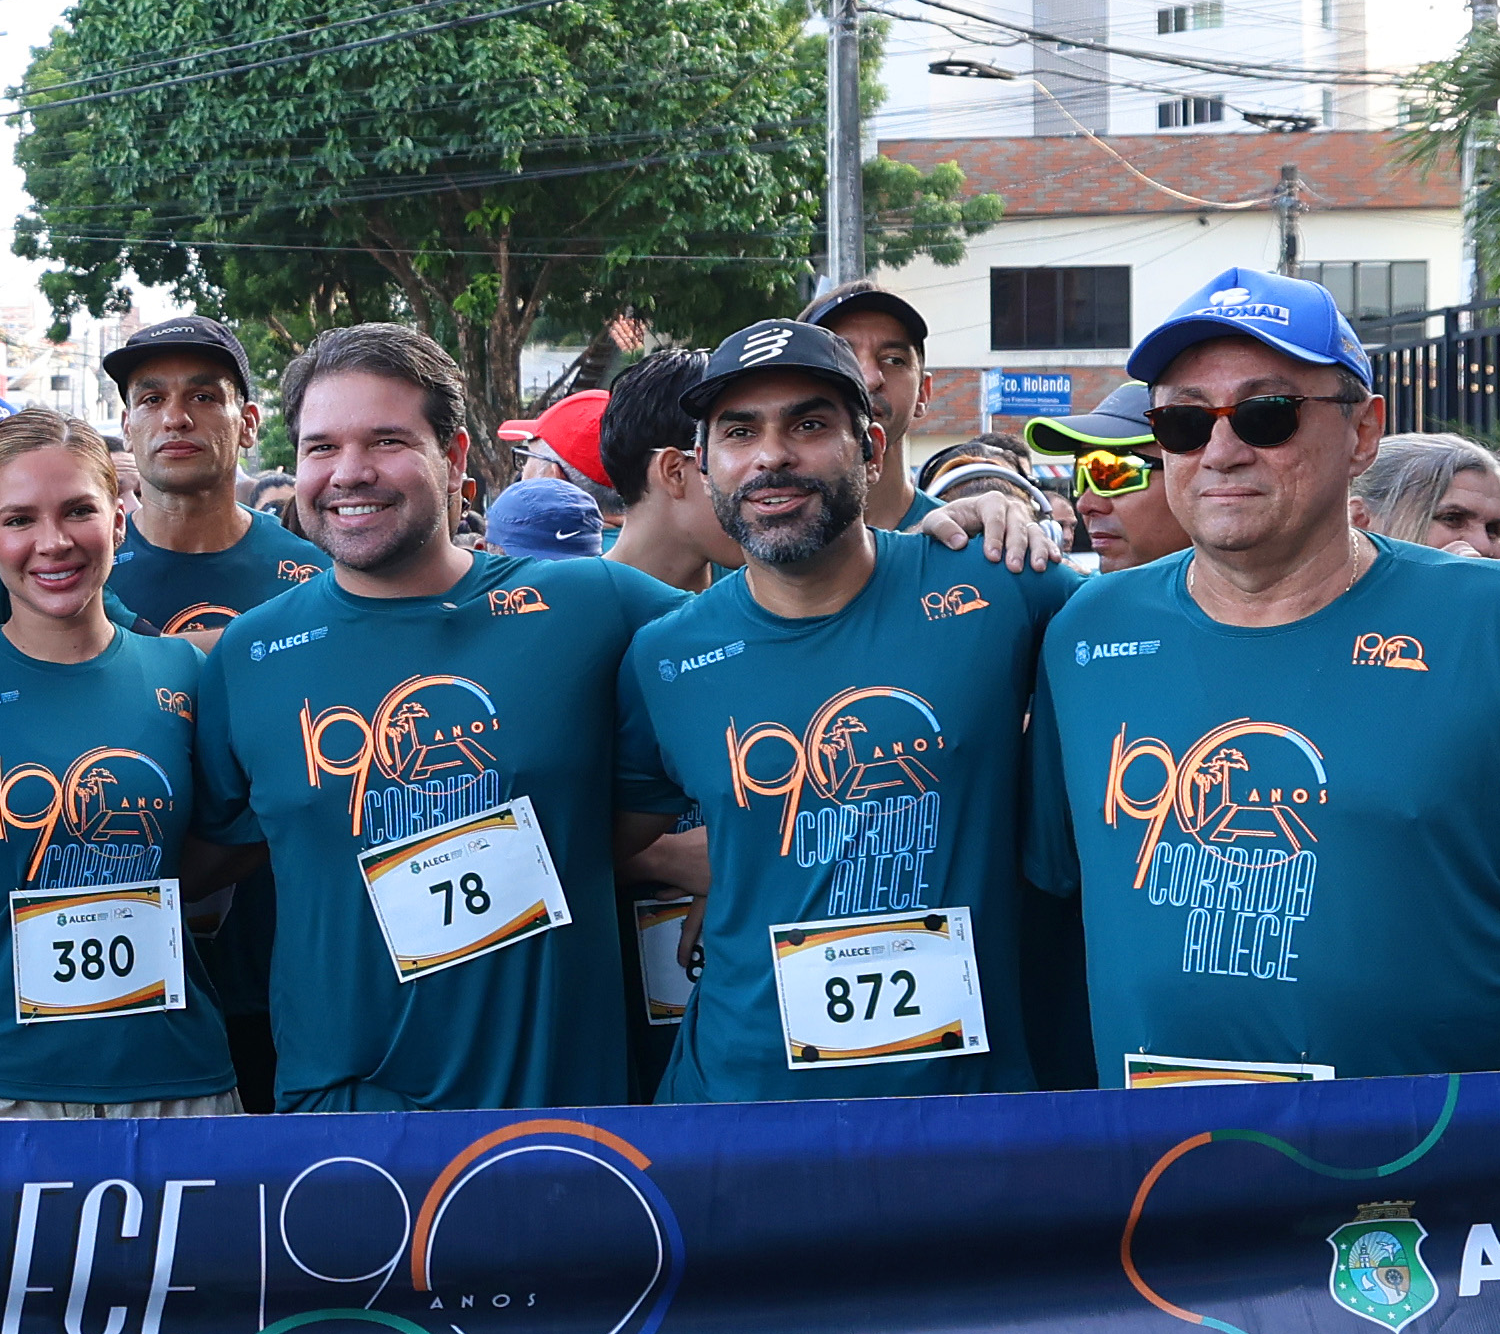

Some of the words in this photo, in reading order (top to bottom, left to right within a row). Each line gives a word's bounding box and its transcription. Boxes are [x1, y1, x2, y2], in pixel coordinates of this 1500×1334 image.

[1024, 375, 1071, 392] Holanda
[269, 632, 309, 653] ALECE
[1092, 641, 1138, 660] ALECE
[680, 648, 725, 673] ALECE
[434, 718, 499, 741] ANOS
[873, 736, 944, 759] ANOS
[1248, 788, 1328, 804] ANOS
[796, 791, 941, 868] CORRIDA
[422, 853, 451, 870] ALECE
[827, 850, 934, 916] ALECE
[1147, 842, 1318, 916] CORRIDA
[429, 872, 491, 927] 78
[68, 914, 97, 924] ALECE
[838, 947, 870, 959] ALECE
[1183, 908, 1305, 982] ALECE
[52, 935, 135, 983] 380
[825, 970, 920, 1023] 872
[430, 1291, 540, 1310] ANOS
